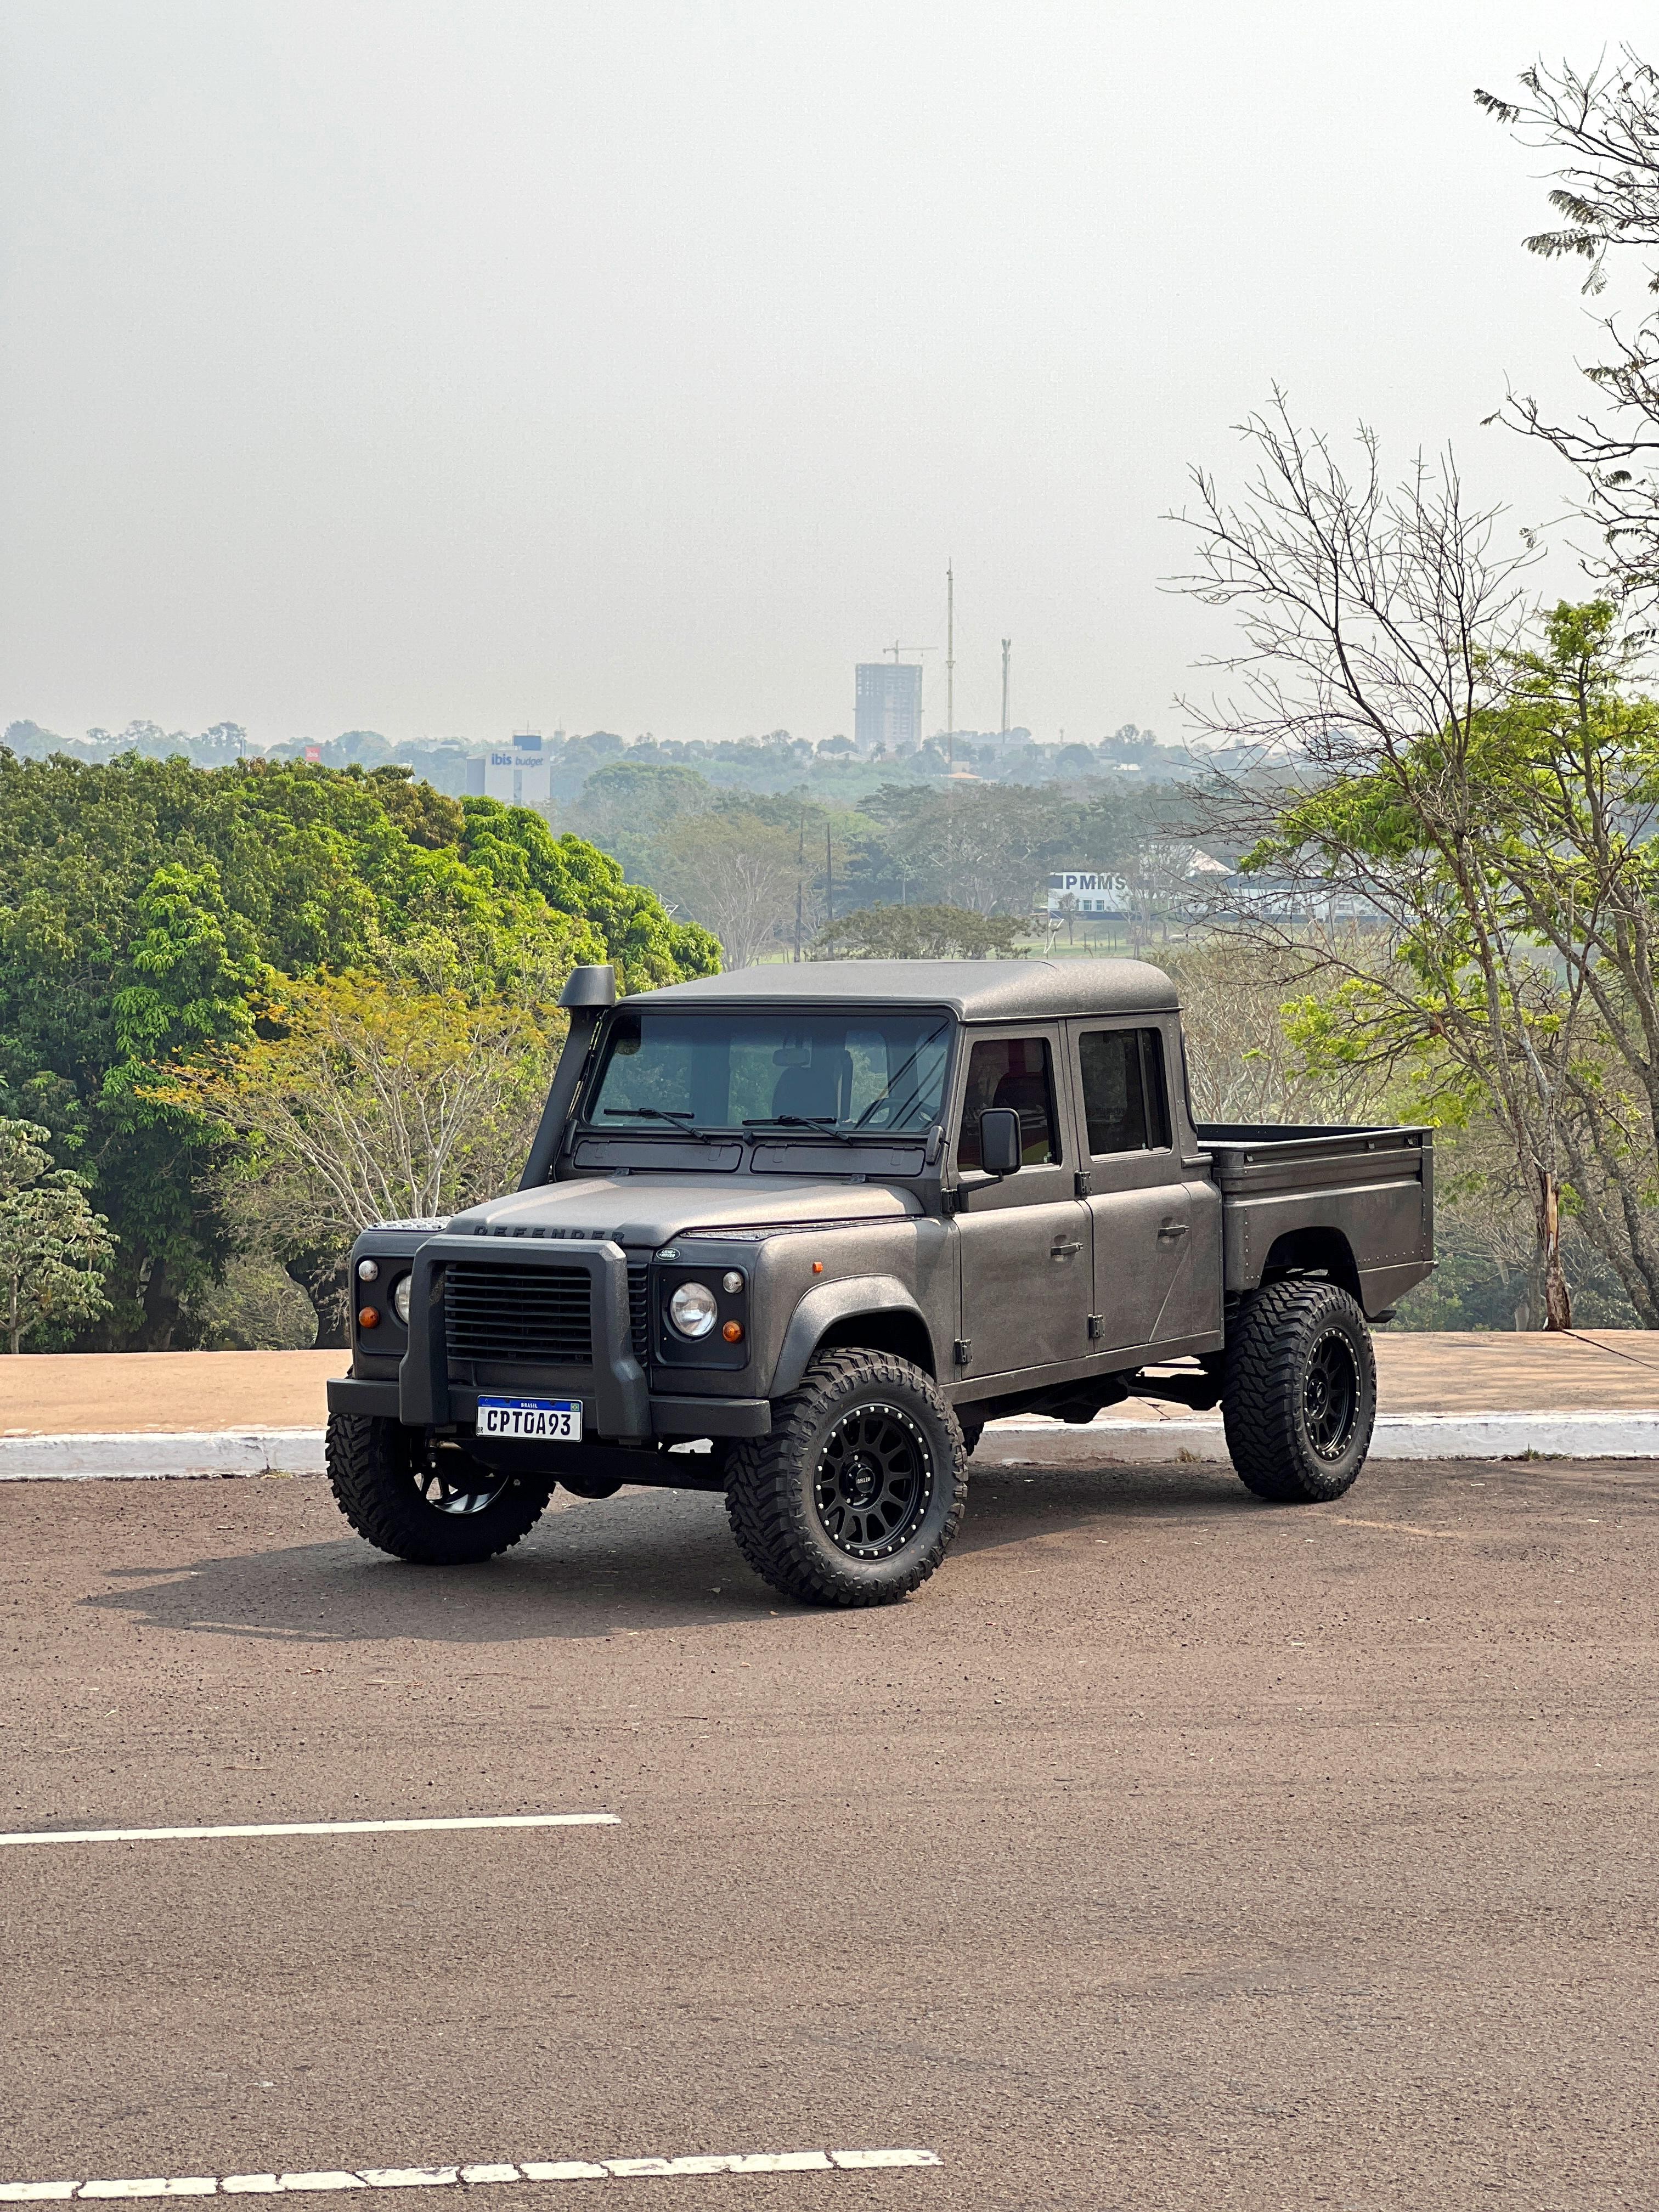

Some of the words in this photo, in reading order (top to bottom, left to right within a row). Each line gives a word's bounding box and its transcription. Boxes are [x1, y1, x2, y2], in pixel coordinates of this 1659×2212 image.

[492, 753, 512, 765] ibis
[516, 757, 543, 767] budget
[1066, 876, 1126, 890] PMMS
[473, 1225, 624, 1244] DEFENDER
[487, 1410, 571, 1436] CPT0A93
